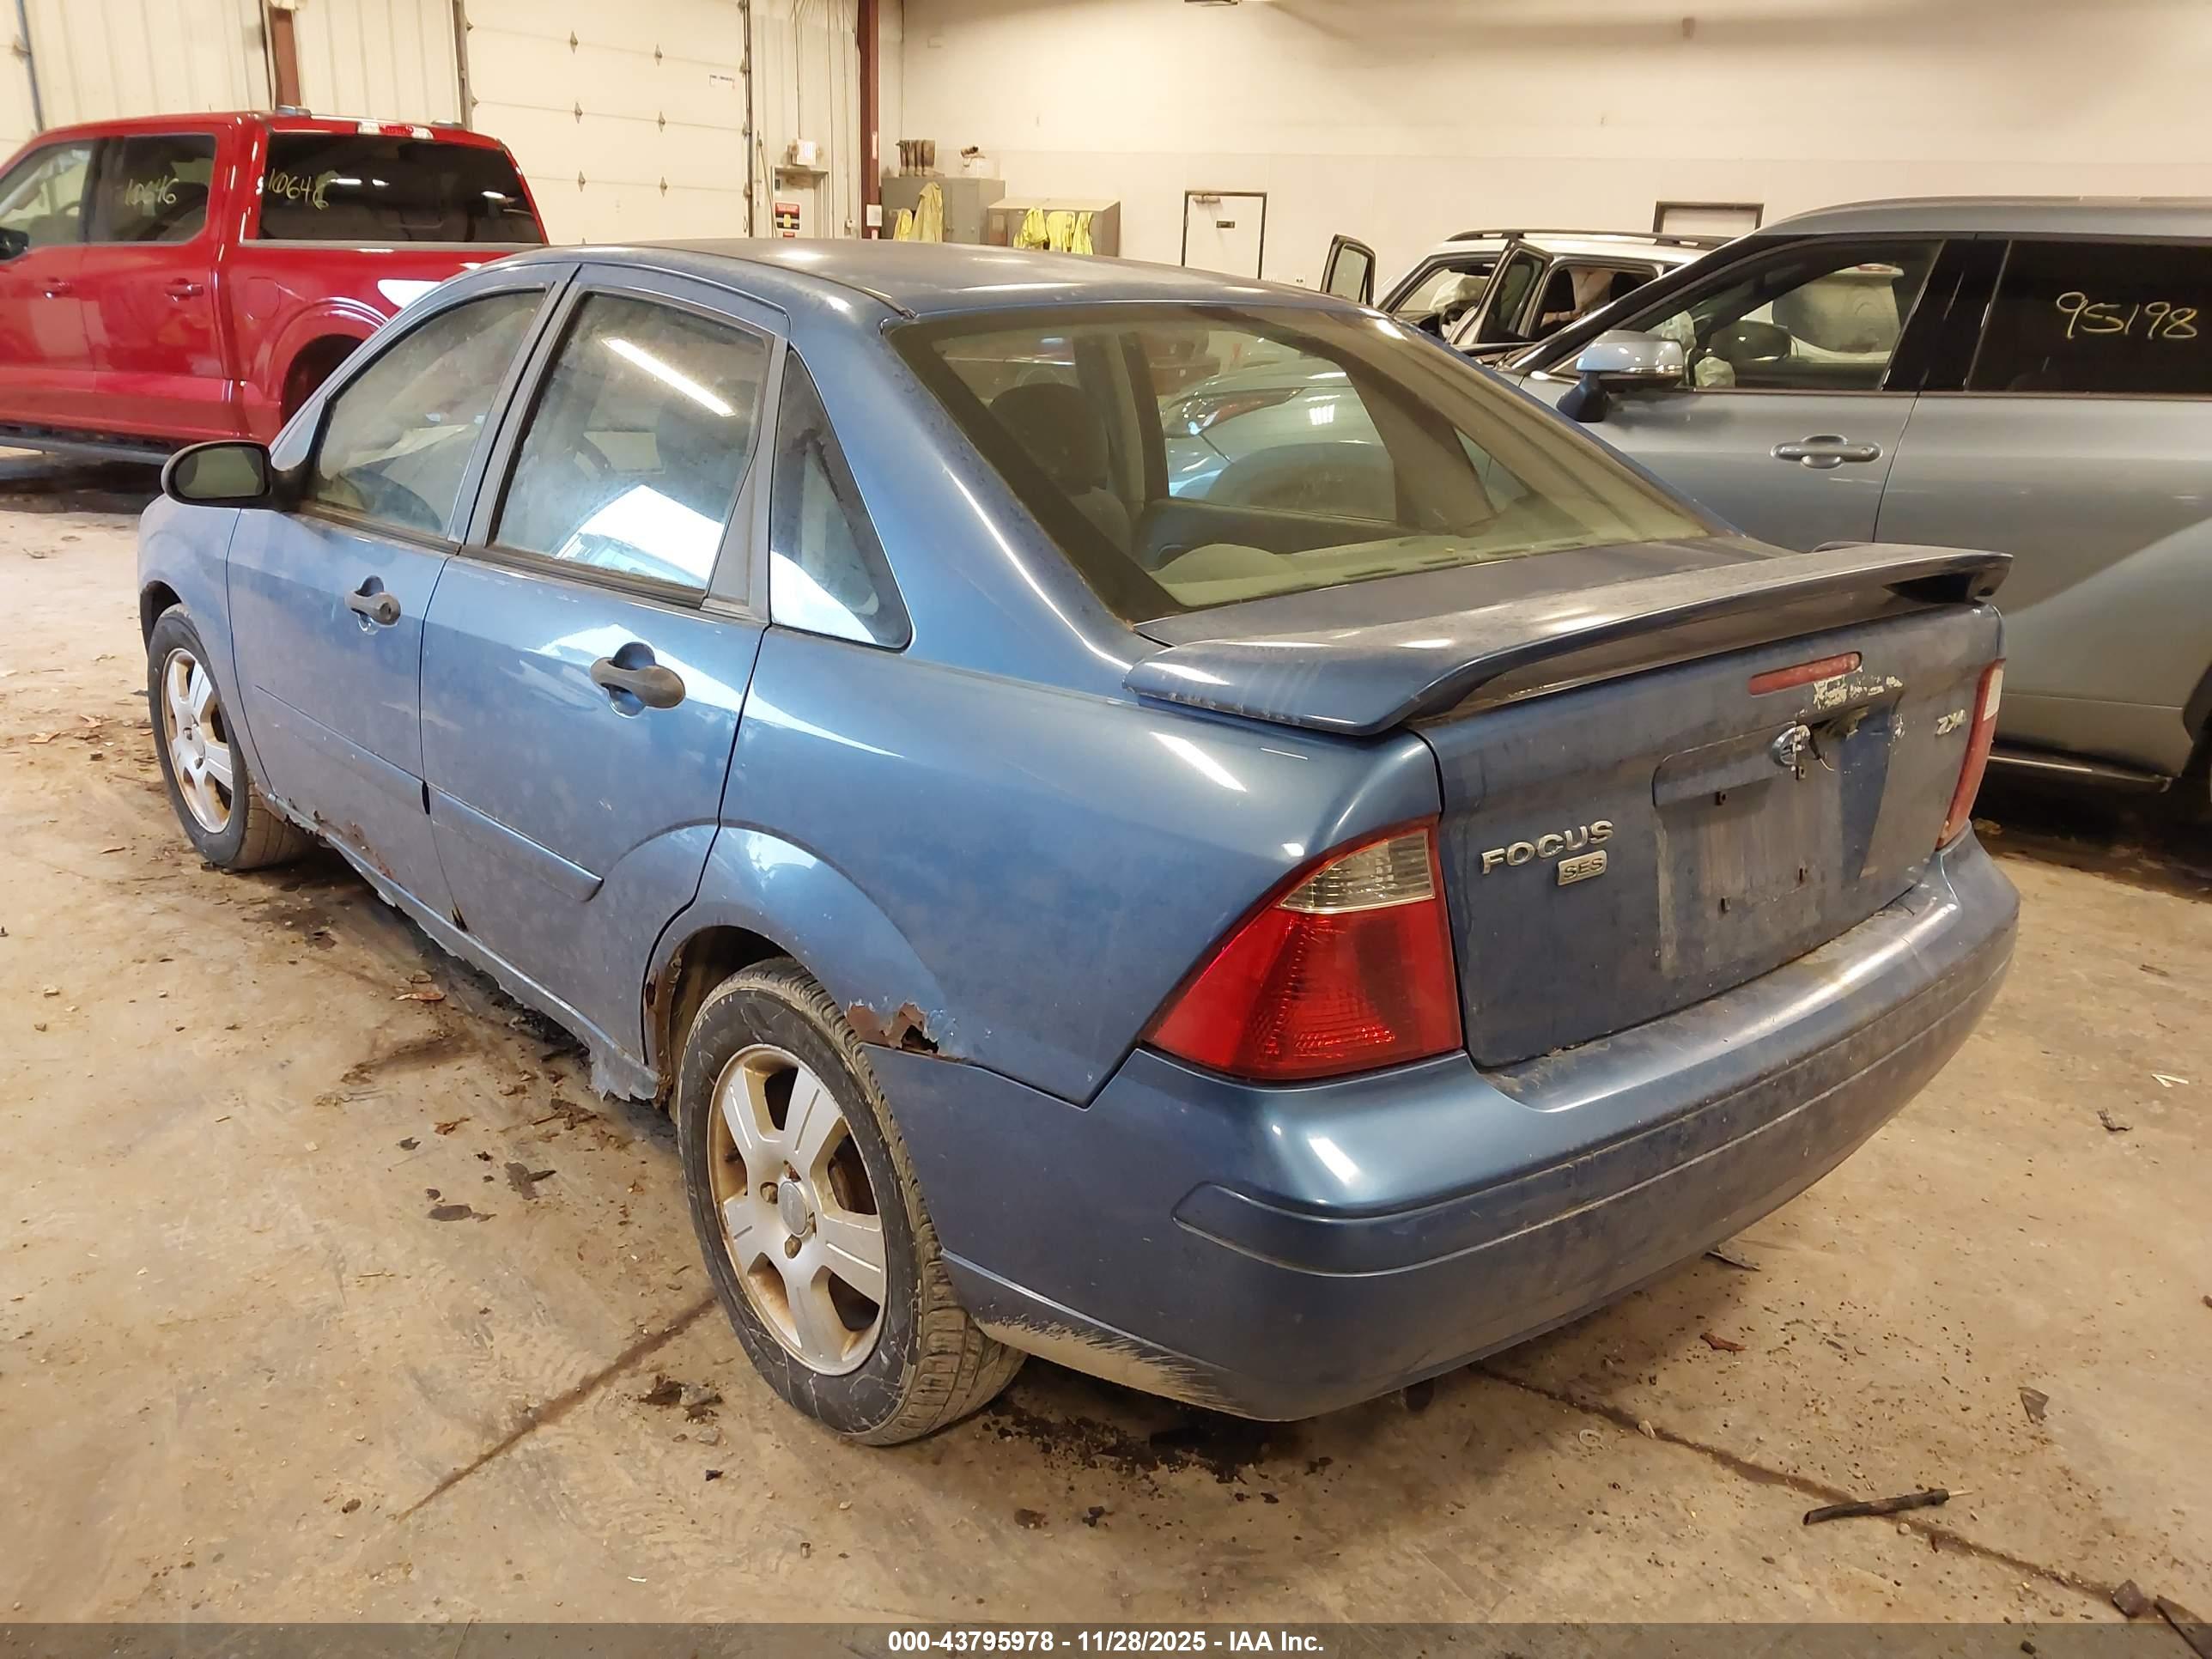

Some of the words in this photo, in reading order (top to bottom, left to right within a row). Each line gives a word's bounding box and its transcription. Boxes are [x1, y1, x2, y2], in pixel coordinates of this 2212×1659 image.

[2056, 291, 2198, 340] 95198
[1480, 820, 1614, 875] FOCUS
[1563, 857, 1604, 880] SES
